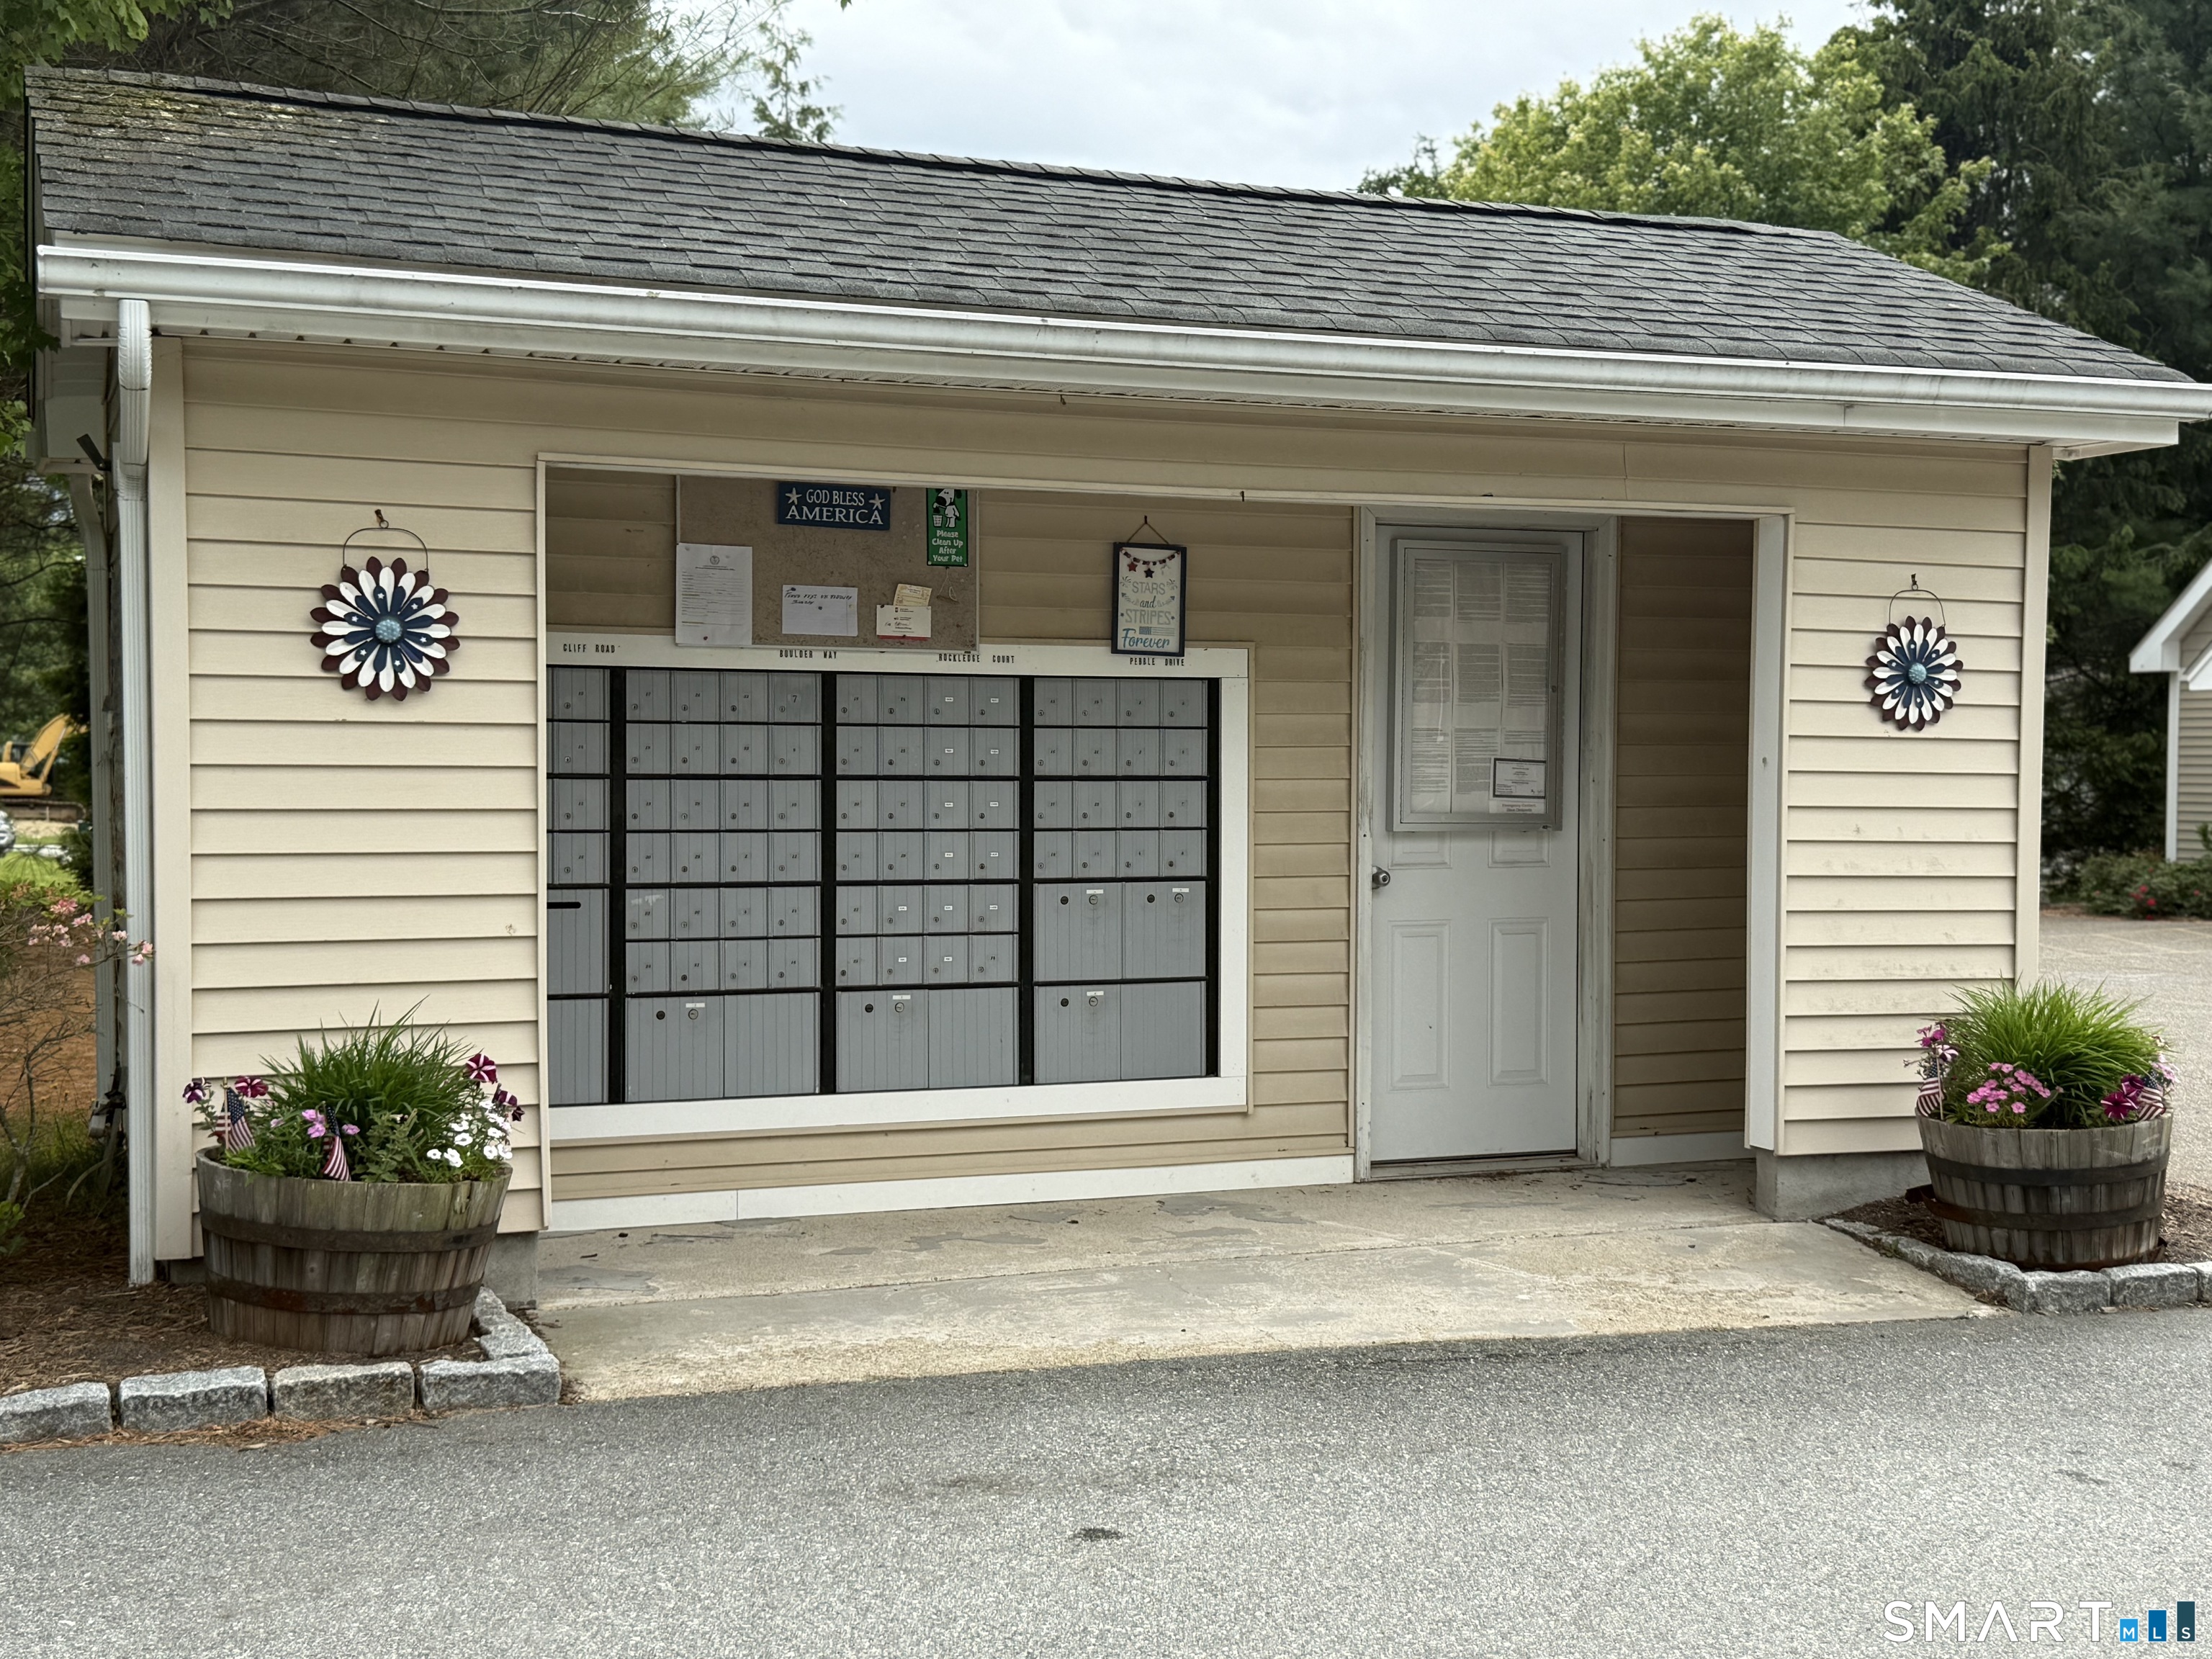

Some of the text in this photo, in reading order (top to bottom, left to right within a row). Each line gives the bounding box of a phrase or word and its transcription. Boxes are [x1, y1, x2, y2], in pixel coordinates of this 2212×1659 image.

[806, 489, 864, 506] GOD BLESS
[786, 505, 884, 525] AMERICA
[953, 539, 963, 548] Up
[1132, 581, 1166, 595] STARS
[1140, 595, 1156, 608] and
[1125, 608, 1172, 625] STRIPES
[1121, 628, 1170, 649] Forever
[563, 643, 615, 653] CLIFF ROAD
[779, 649, 837, 659] BOULDER WAY
[938, 653, 1015, 663] ROCKLEDGE COURT
[792, 695, 798, 703] 7
